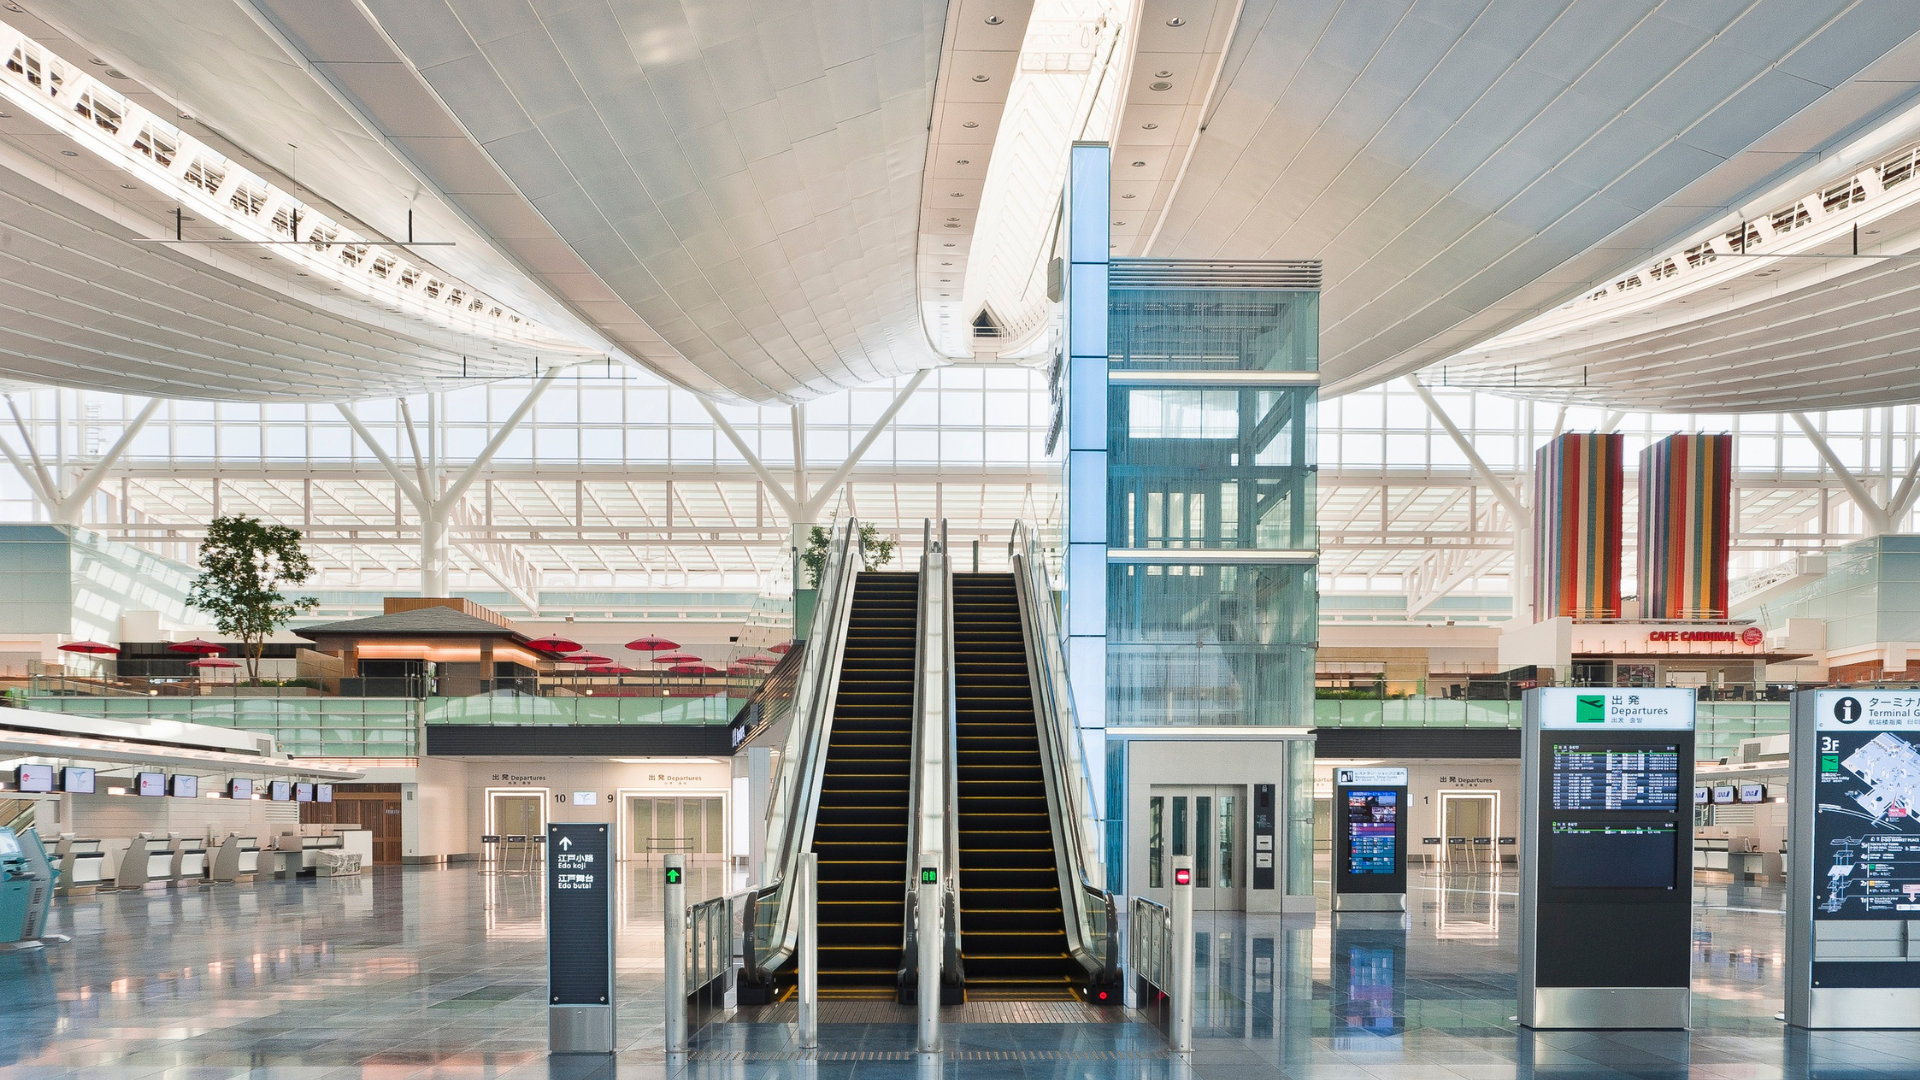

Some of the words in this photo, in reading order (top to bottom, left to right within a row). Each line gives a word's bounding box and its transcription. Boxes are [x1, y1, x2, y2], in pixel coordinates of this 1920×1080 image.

[1650, 631, 1678, 641] CAFE
[1681, 631, 1738, 641] CARDINAL
[1611, 706, 1668, 717] Departures
[1869, 709, 1910, 717] Terminal
[1821, 737, 1839, 751] 3F
[554, 794, 566, 803] 10
[607, 794, 614, 803] 9
[1423, 796, 1429, 805] 1
[558, 854, 594, 863] 江戸小路
[572, 862, 587, 870] koji
